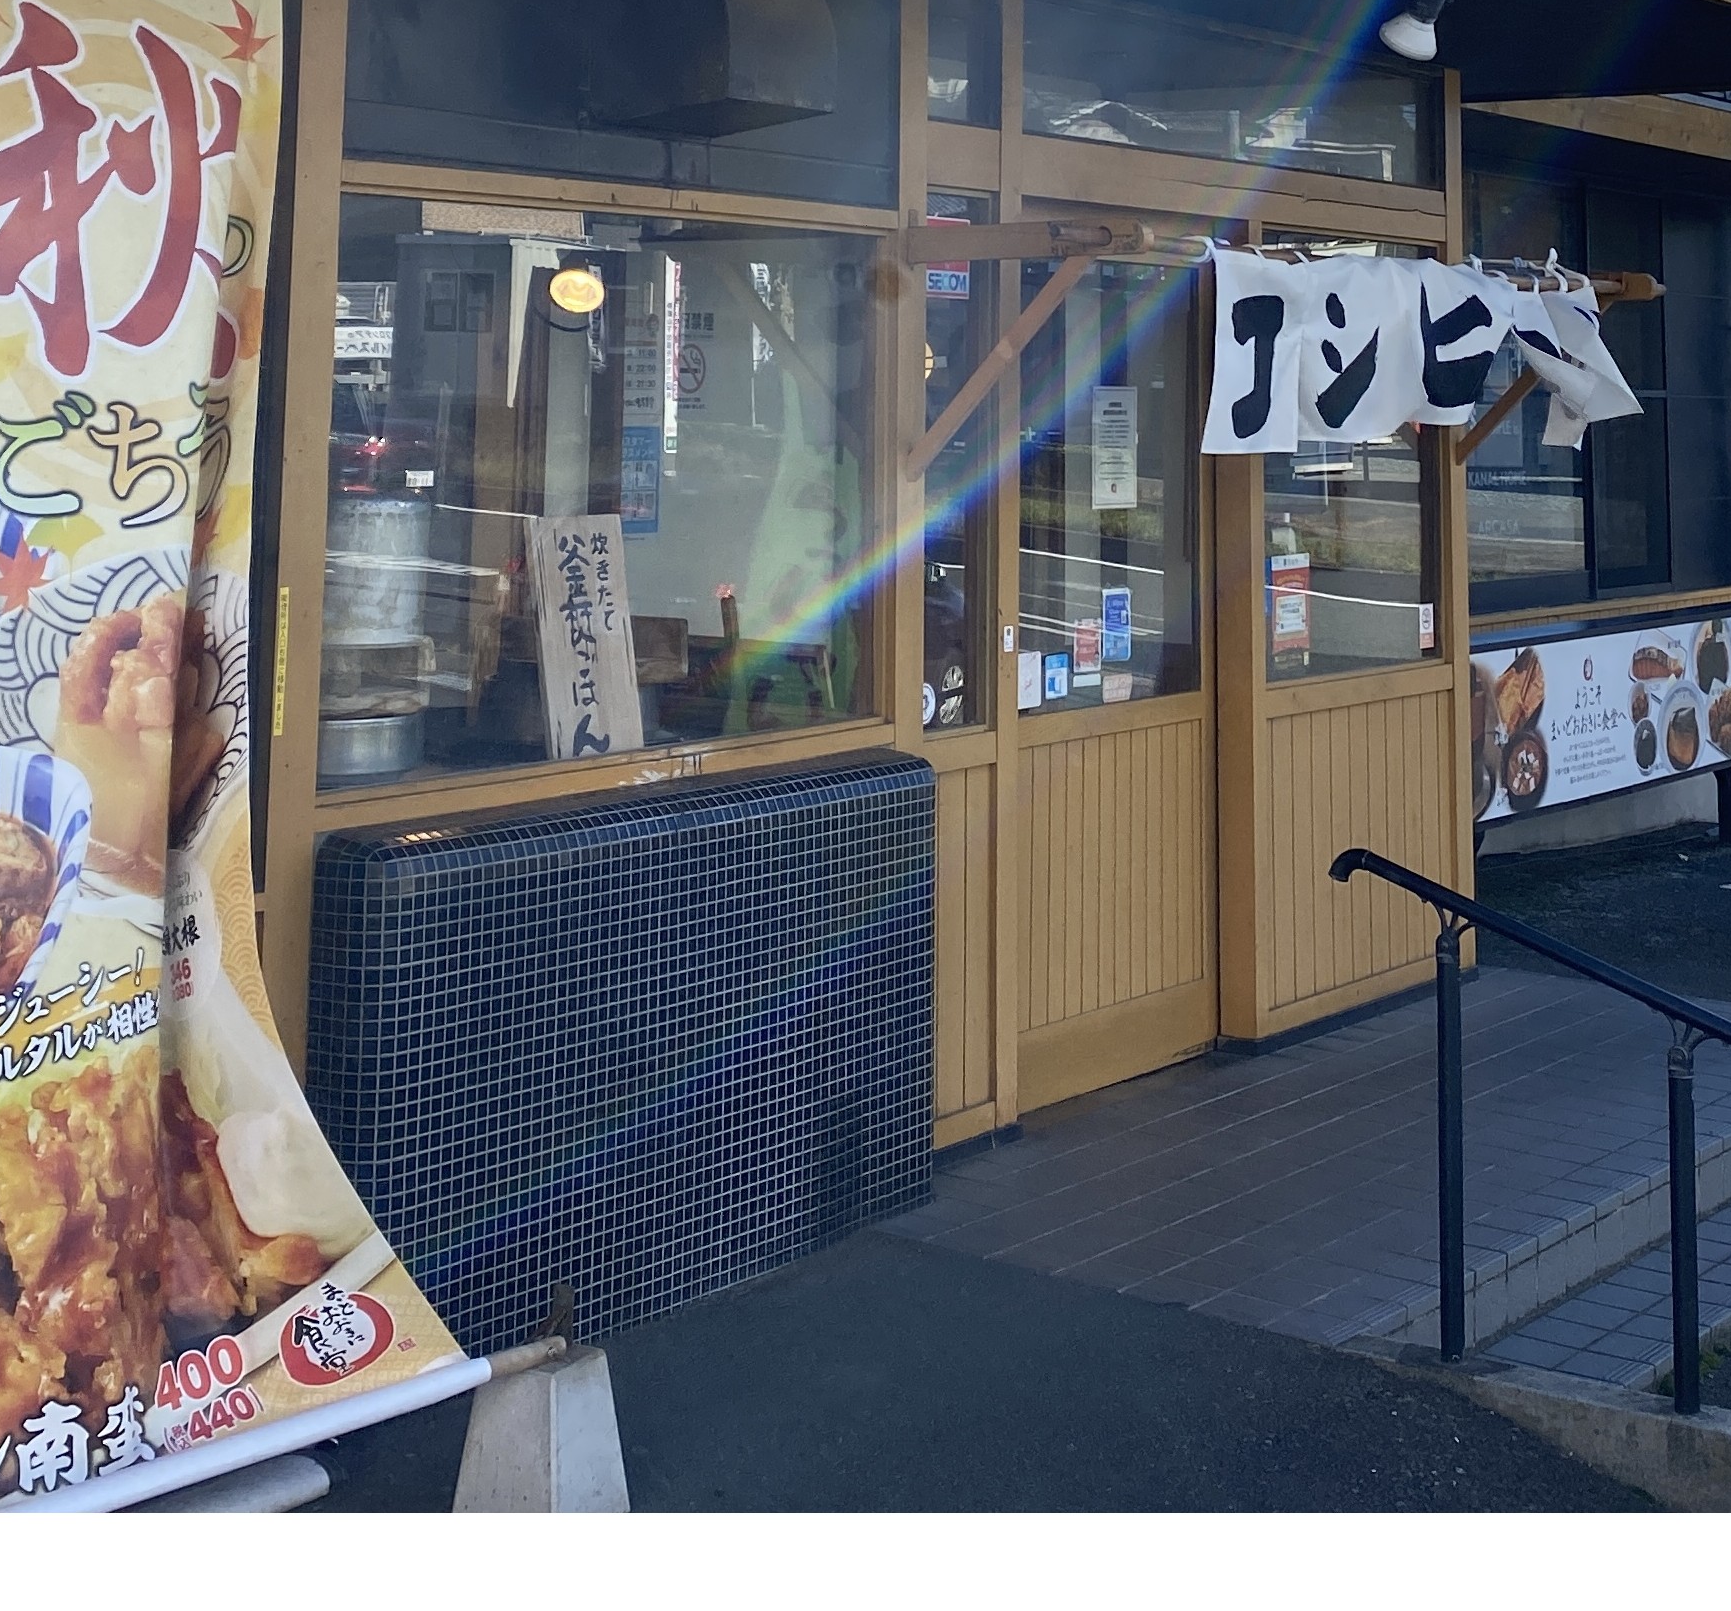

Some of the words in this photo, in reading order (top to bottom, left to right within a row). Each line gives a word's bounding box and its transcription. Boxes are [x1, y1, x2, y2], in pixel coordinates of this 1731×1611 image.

[928, 273, 966, 292] SECOM
[591, 532, 615, 631] 炊きたて
[1574, 685, 1602, 710] ようこそ
[155, 1336, 244, 1410] 400
